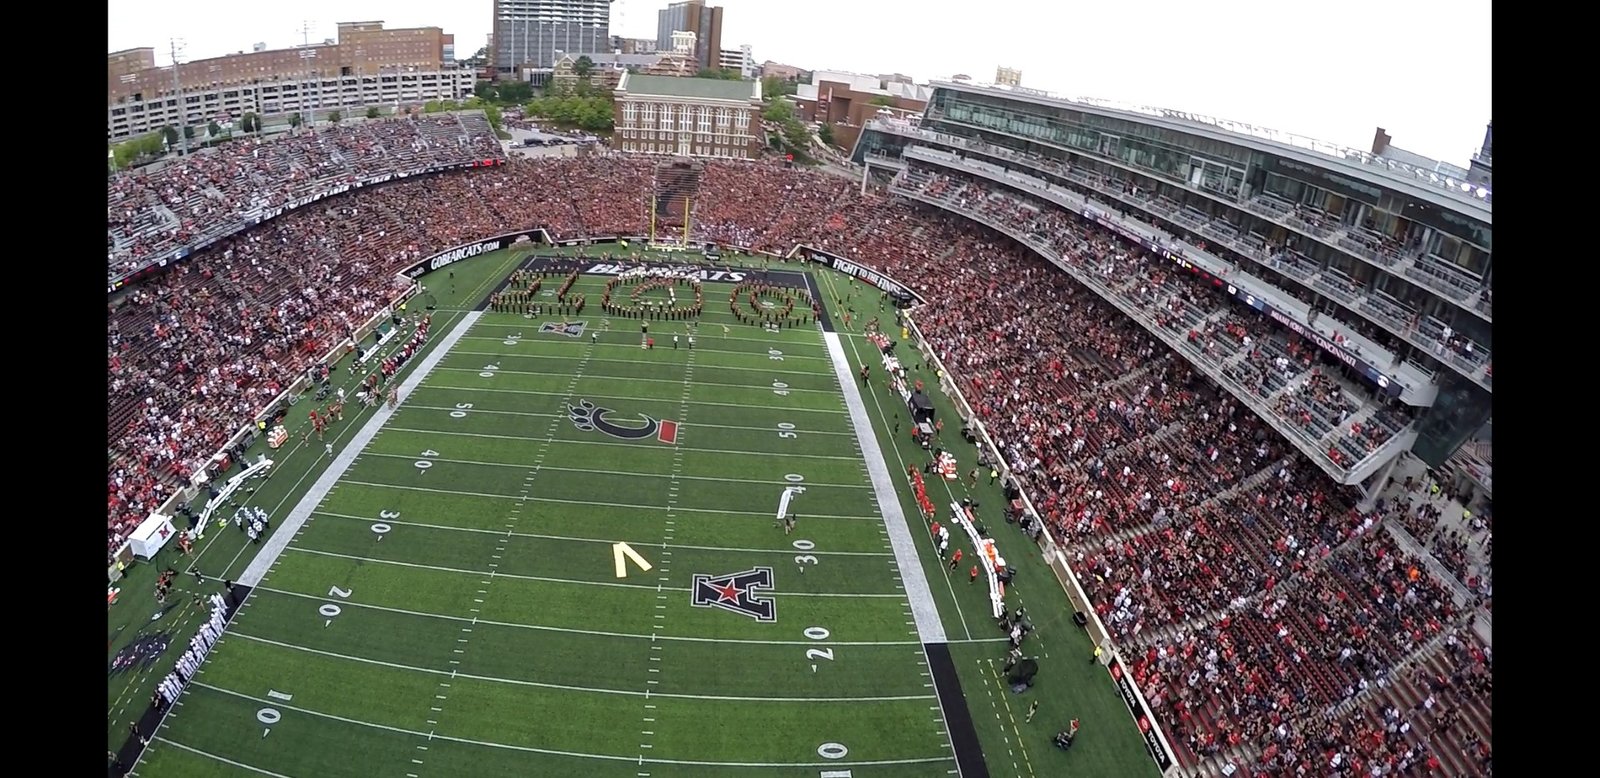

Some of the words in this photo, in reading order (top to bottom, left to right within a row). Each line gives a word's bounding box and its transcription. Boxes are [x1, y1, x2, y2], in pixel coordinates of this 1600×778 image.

[833, 258, 859, 276] FIGHT
[858, 268, 868, 278] TO
[867, 271, 880, 284] THE
[877, 277, 908, 296] FINIS
[1315, 336, 1357, 367] CINCINNATI
[450, 402, 473, 417] 50
[777, 422, 797, 439] 50
[414, 449, 440, 469] 40
[371, 509, 400, 534] 30
[792, 539, 818, 566] 30
[319, 585, 352, 617] 20
[803, 626, 834, 661] 20
[256, 689, 293, 724] 10
[1120, 677, 1136, 708] TOYOTA
[1148, 729, 1165, 764] TOYOTA
